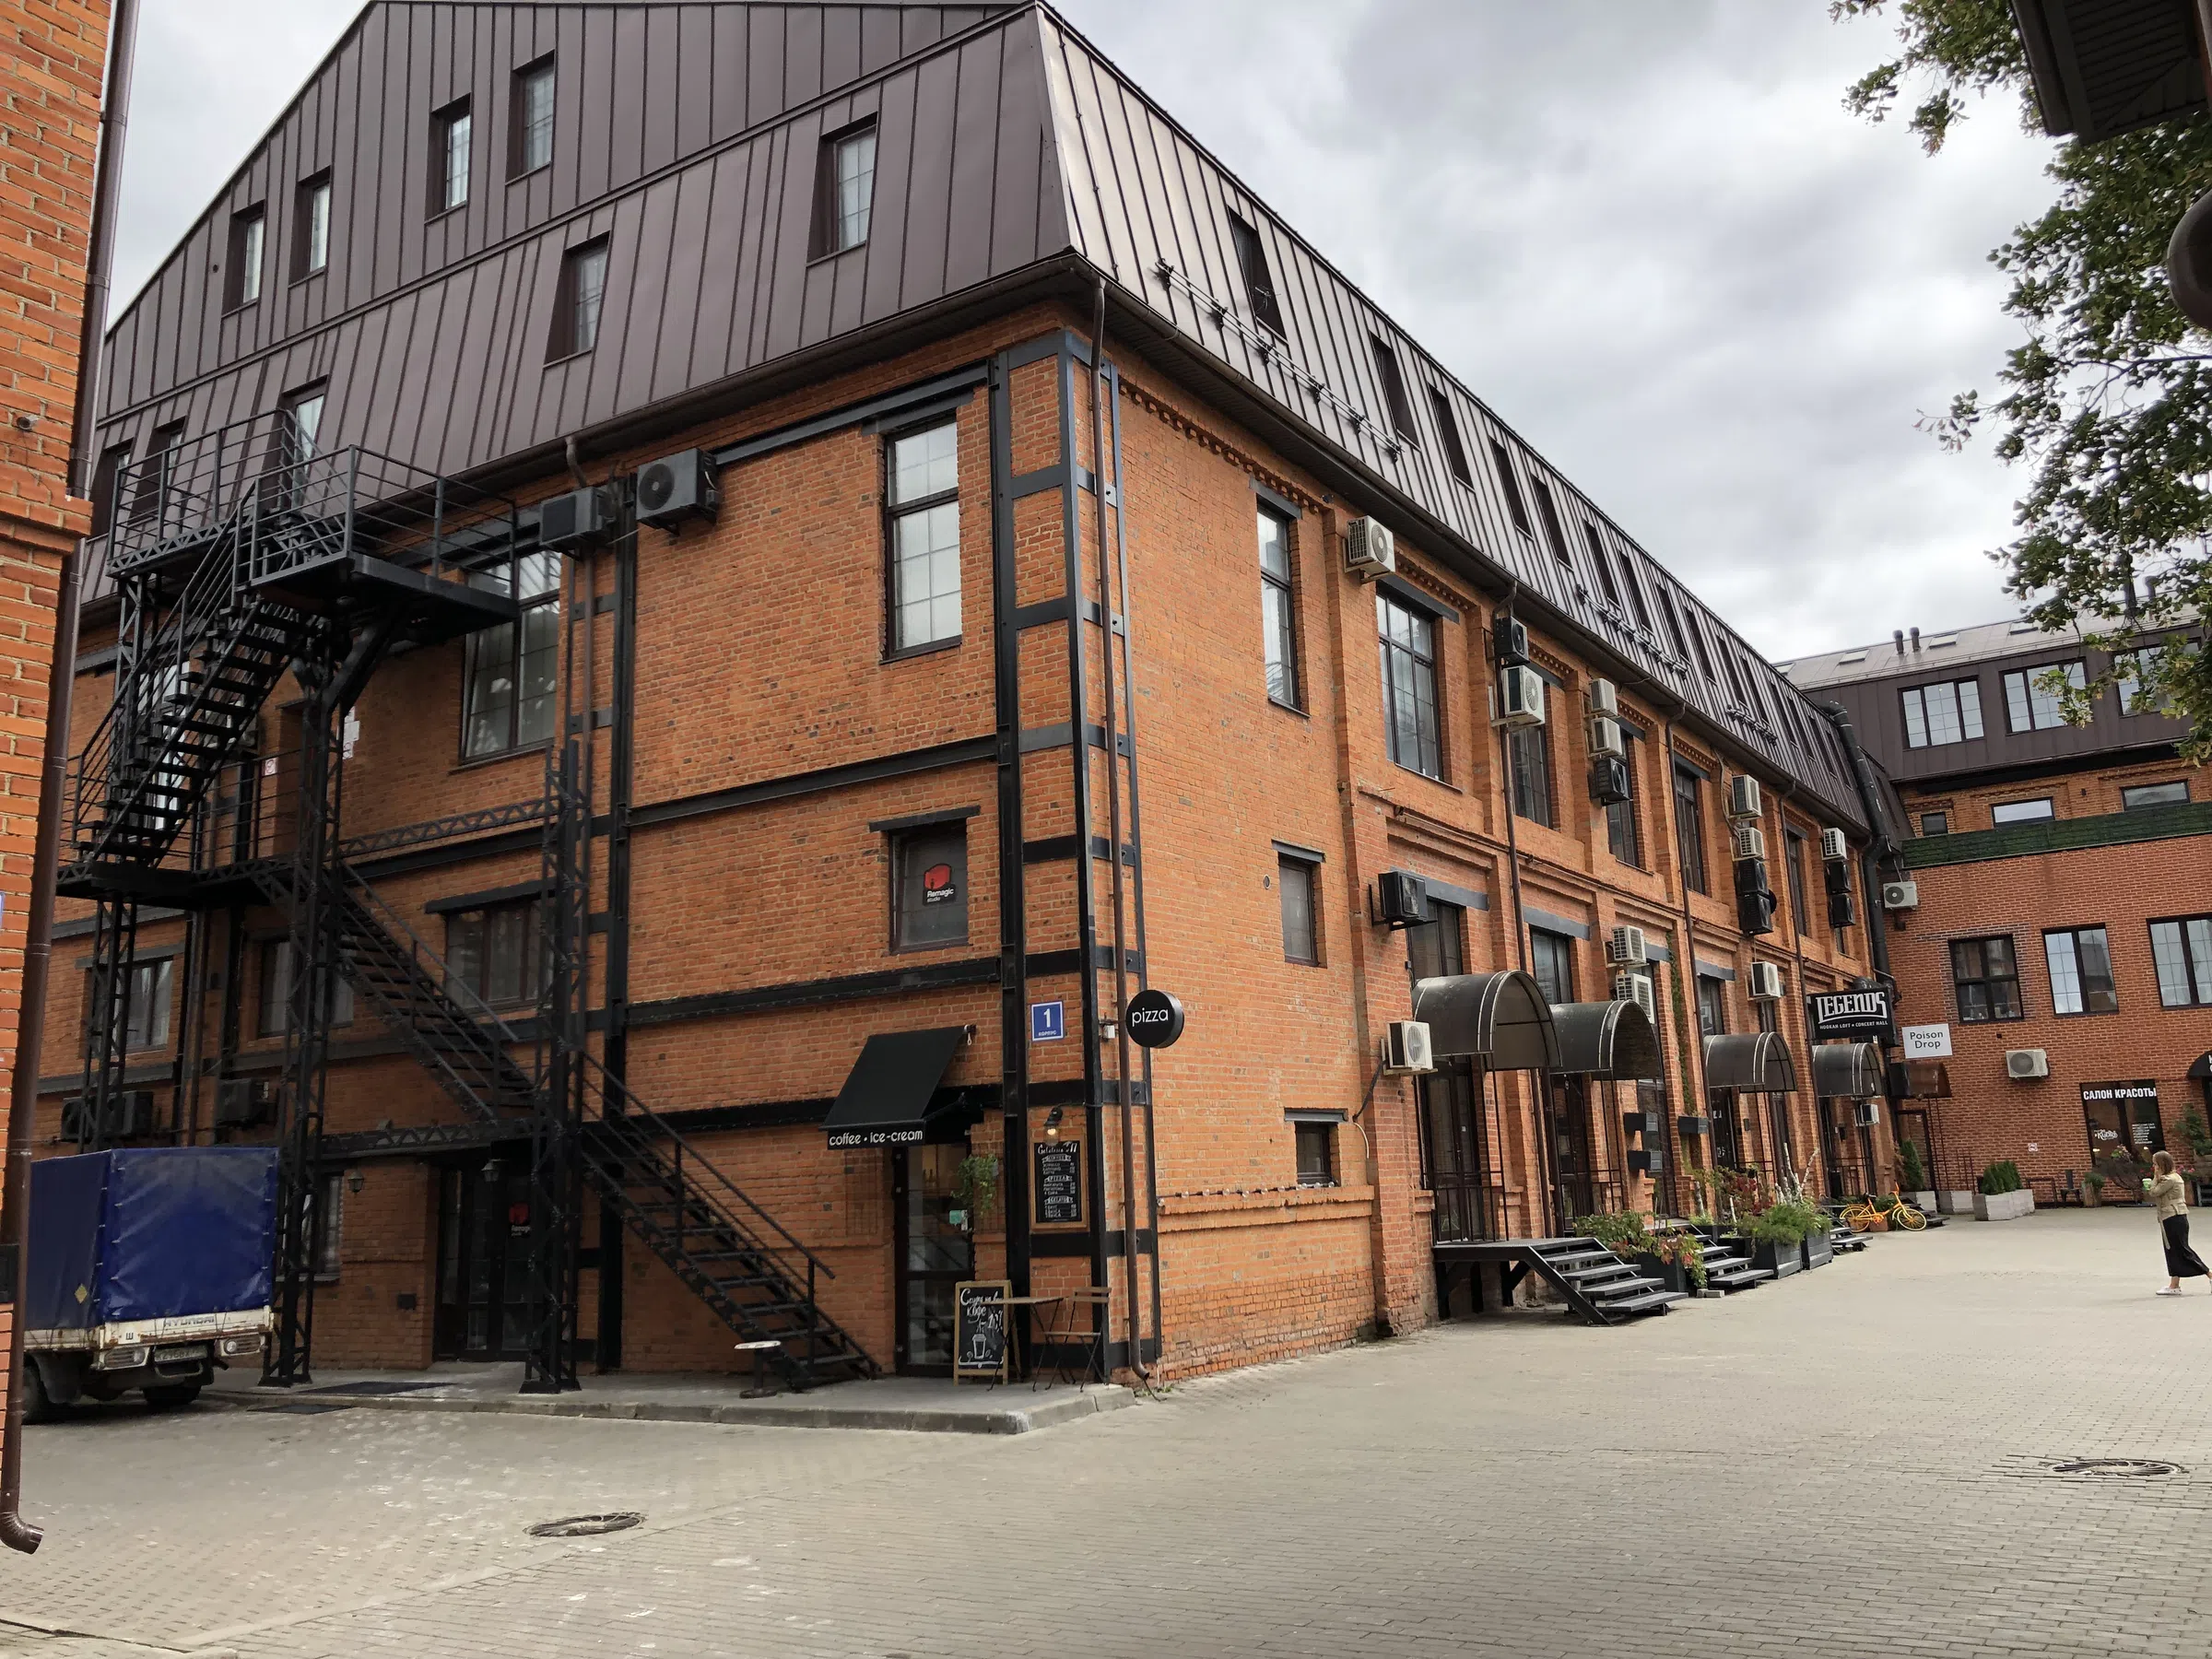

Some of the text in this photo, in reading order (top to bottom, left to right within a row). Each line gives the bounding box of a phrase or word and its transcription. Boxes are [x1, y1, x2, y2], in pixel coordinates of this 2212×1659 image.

[927, 888, 954, 898] Remagic
[1816, 992, 1888, 1024] LEGENDS
[1043, 1008, 1051, 1028] 1
[1132, 1007, 1168, 1027] pizza
[1910, 1030, 1943, 1040] Poison
[1914, 1040, 1941, 1049] Drop
[2083, 1088, 2157, 1100] САЛОН КРАСОТЫ
[830, 1130, 923, 1146] coffee ice-cream
[164, 1315, 215, 1327] HYUNDAI
